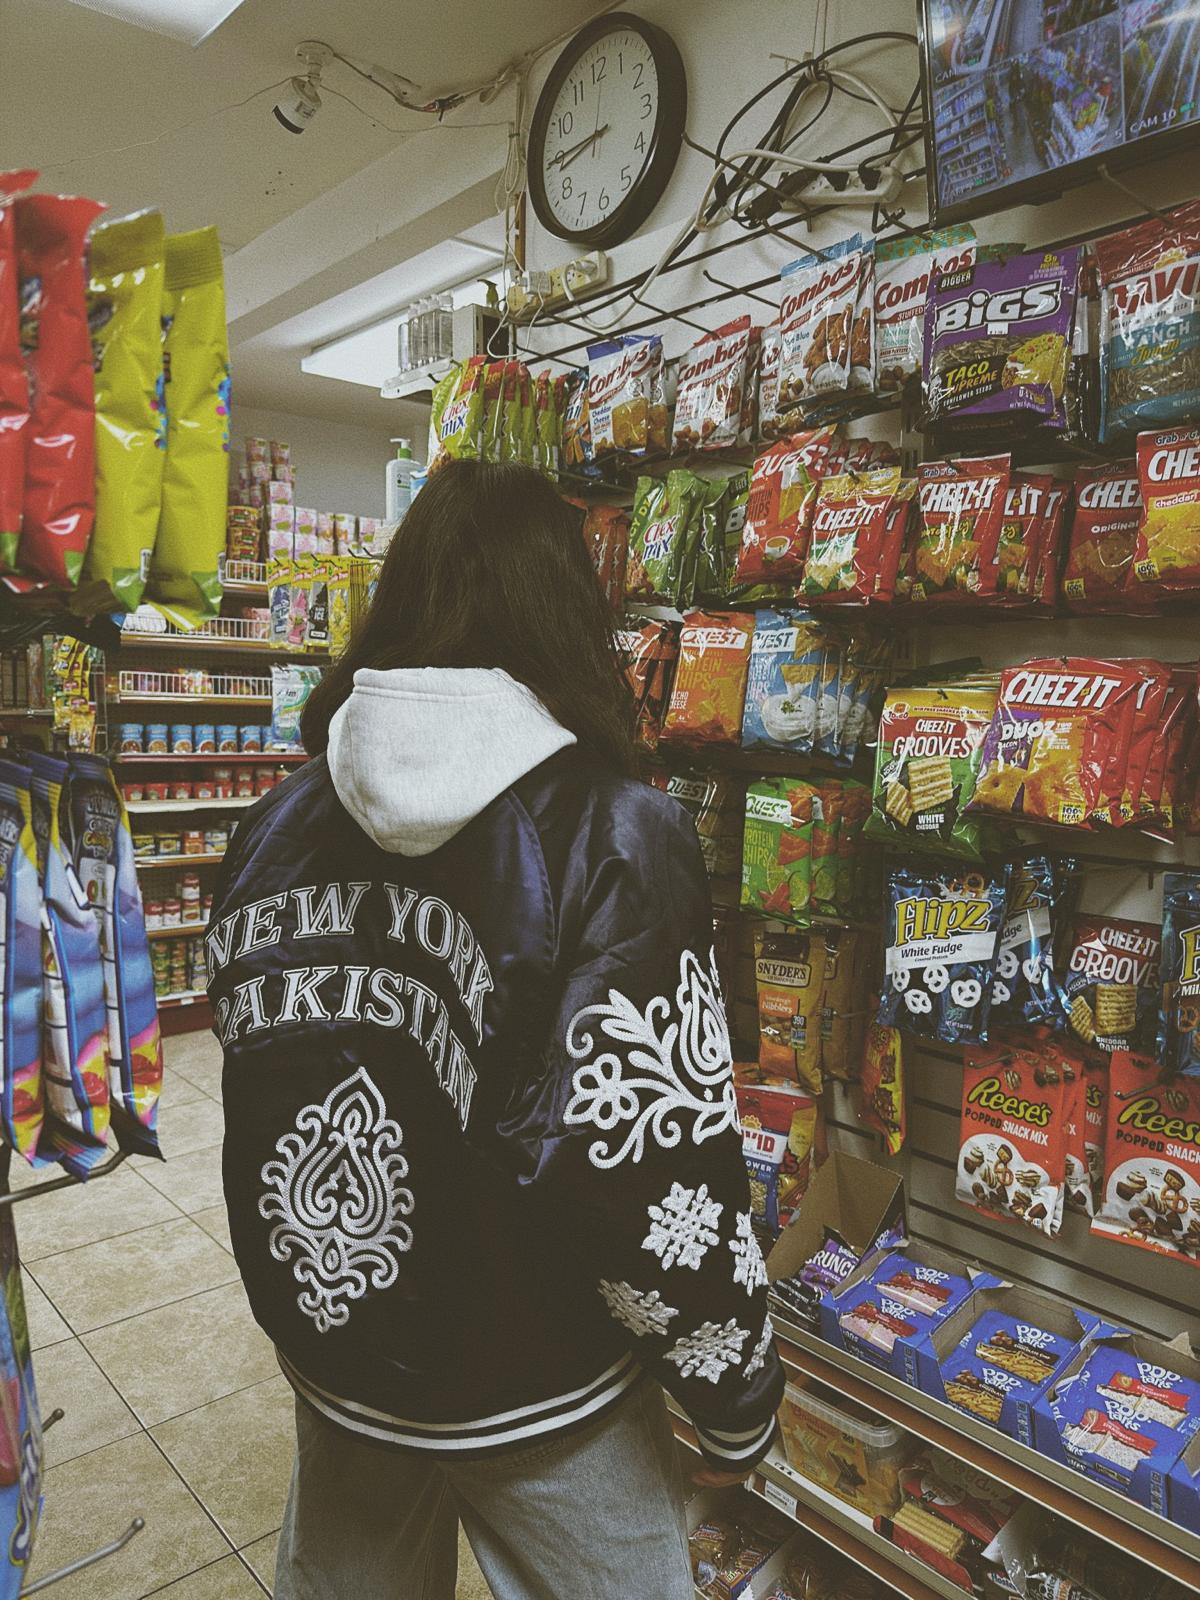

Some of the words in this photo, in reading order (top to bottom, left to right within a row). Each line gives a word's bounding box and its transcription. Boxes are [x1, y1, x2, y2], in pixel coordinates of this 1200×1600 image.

[590, 56, 607, 85] 12
[617, 52, 624, 75] 1
[632, 63, 645, 90] 2
[572, 80, 585, 106] 11
[639, 93, 652, 120] 3
[558, 112, 574, 139] 10
[1130, 115, 1158, 134] CAM
[1161, 109, 1177, 124] 10
[633, 131, 646, 154] 4
[555, 150, 566, 168] 9
[561, 176, 573, 200] 8
[620, 166, 633, 192] 5
[577, 192, 588, 217] 7
[598, 188, 610, 211] 6
[780, 258, 856, 323] Combos
[1110, 261, 1200, 321] DAVI
[589, 344, 649, 399] Combos
[946, 360, 990, 385] TACO
[440, 399, 469, 424] Chex
[1154, 432, 1179, 447] Grab
[1147, 446, 1200, 482] CHE
[1153, 492, 1198, 510] cheddar
[642, 533, 673, 563] mix
[892, 735, 972, 759] GROOVES
[917, 813, 945, 824] WHITE
[896, 896, 991, 948] Flipz
[900, 946, 930, 958] White
[931, 942, 963, 956] Fudge
[205, 882, 371, 988] NEW
[384, 882, 494, 1047] YORK
[215, 965, 478, 1132] PAKISTAN
[967, 1076, 1053, 1128] Reese's
[1001, 1119, 1030, 1138] SNACK
[1118, 1097, 1200, 1144] Reese
